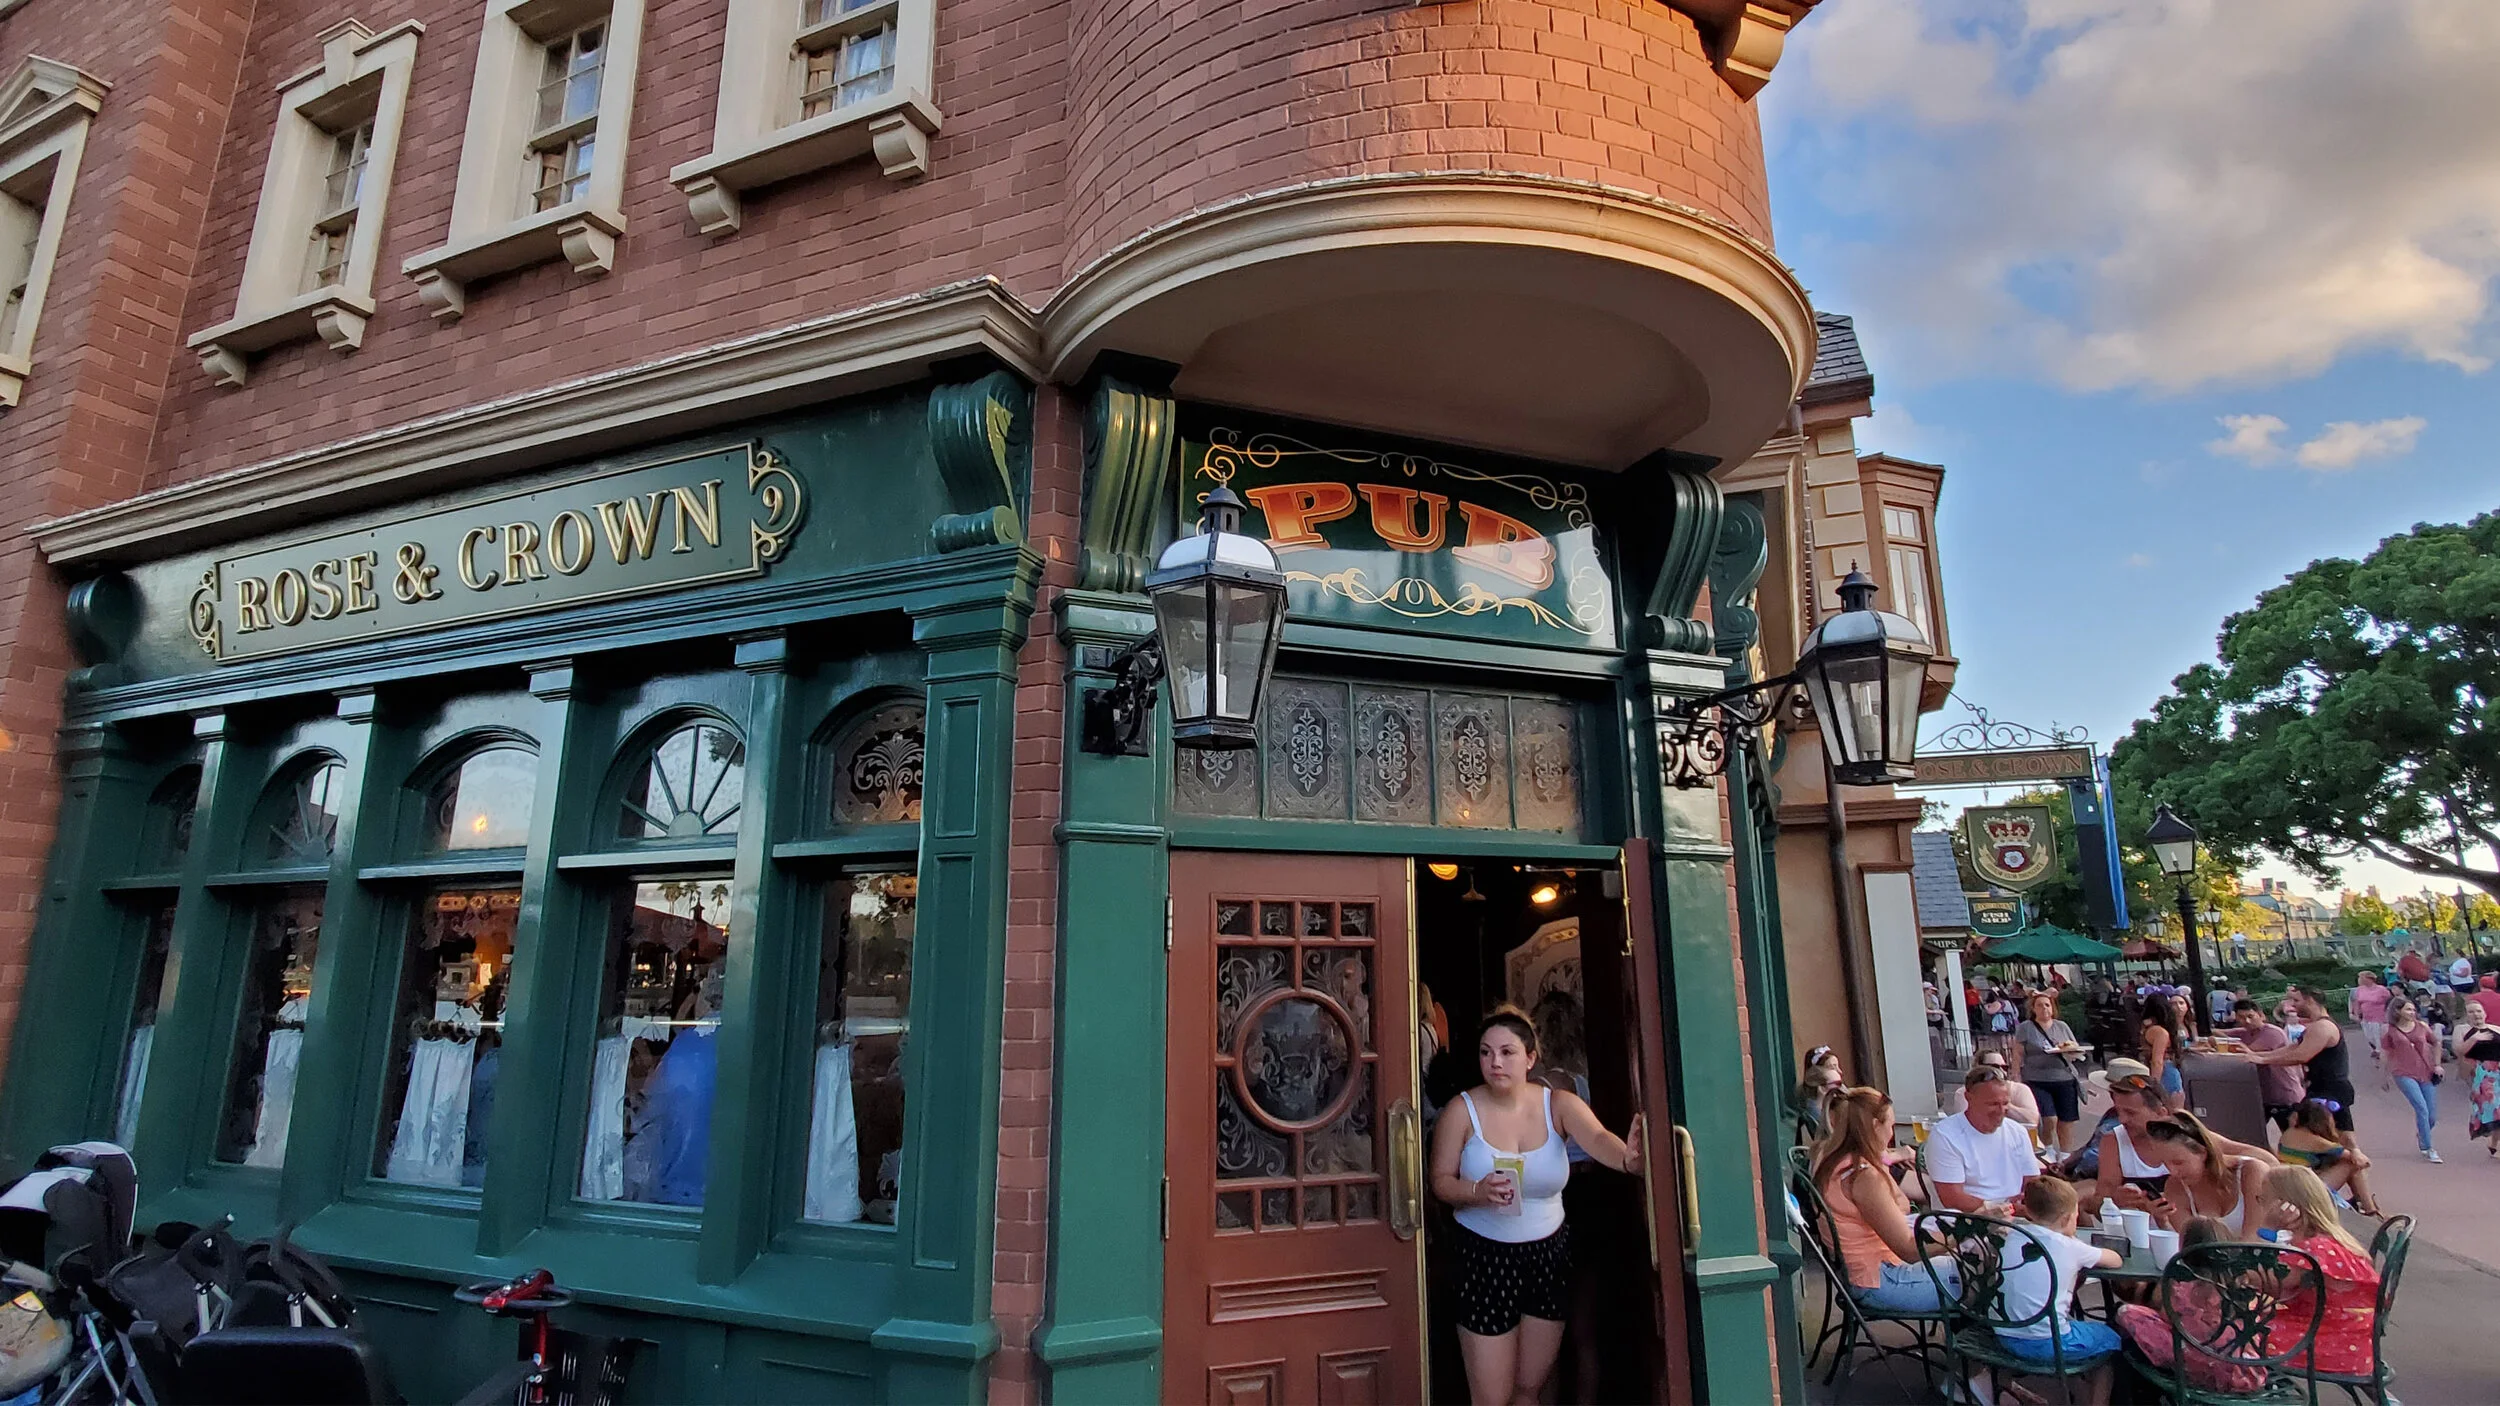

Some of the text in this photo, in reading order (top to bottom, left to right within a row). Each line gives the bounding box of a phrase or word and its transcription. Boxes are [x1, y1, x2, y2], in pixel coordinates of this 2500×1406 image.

[235, 478, 722, 633] ROSE & CROWN
[1245, 481, 1556, 591] PUB
[1914, 754, 2083, 780] OSE & CROWN
